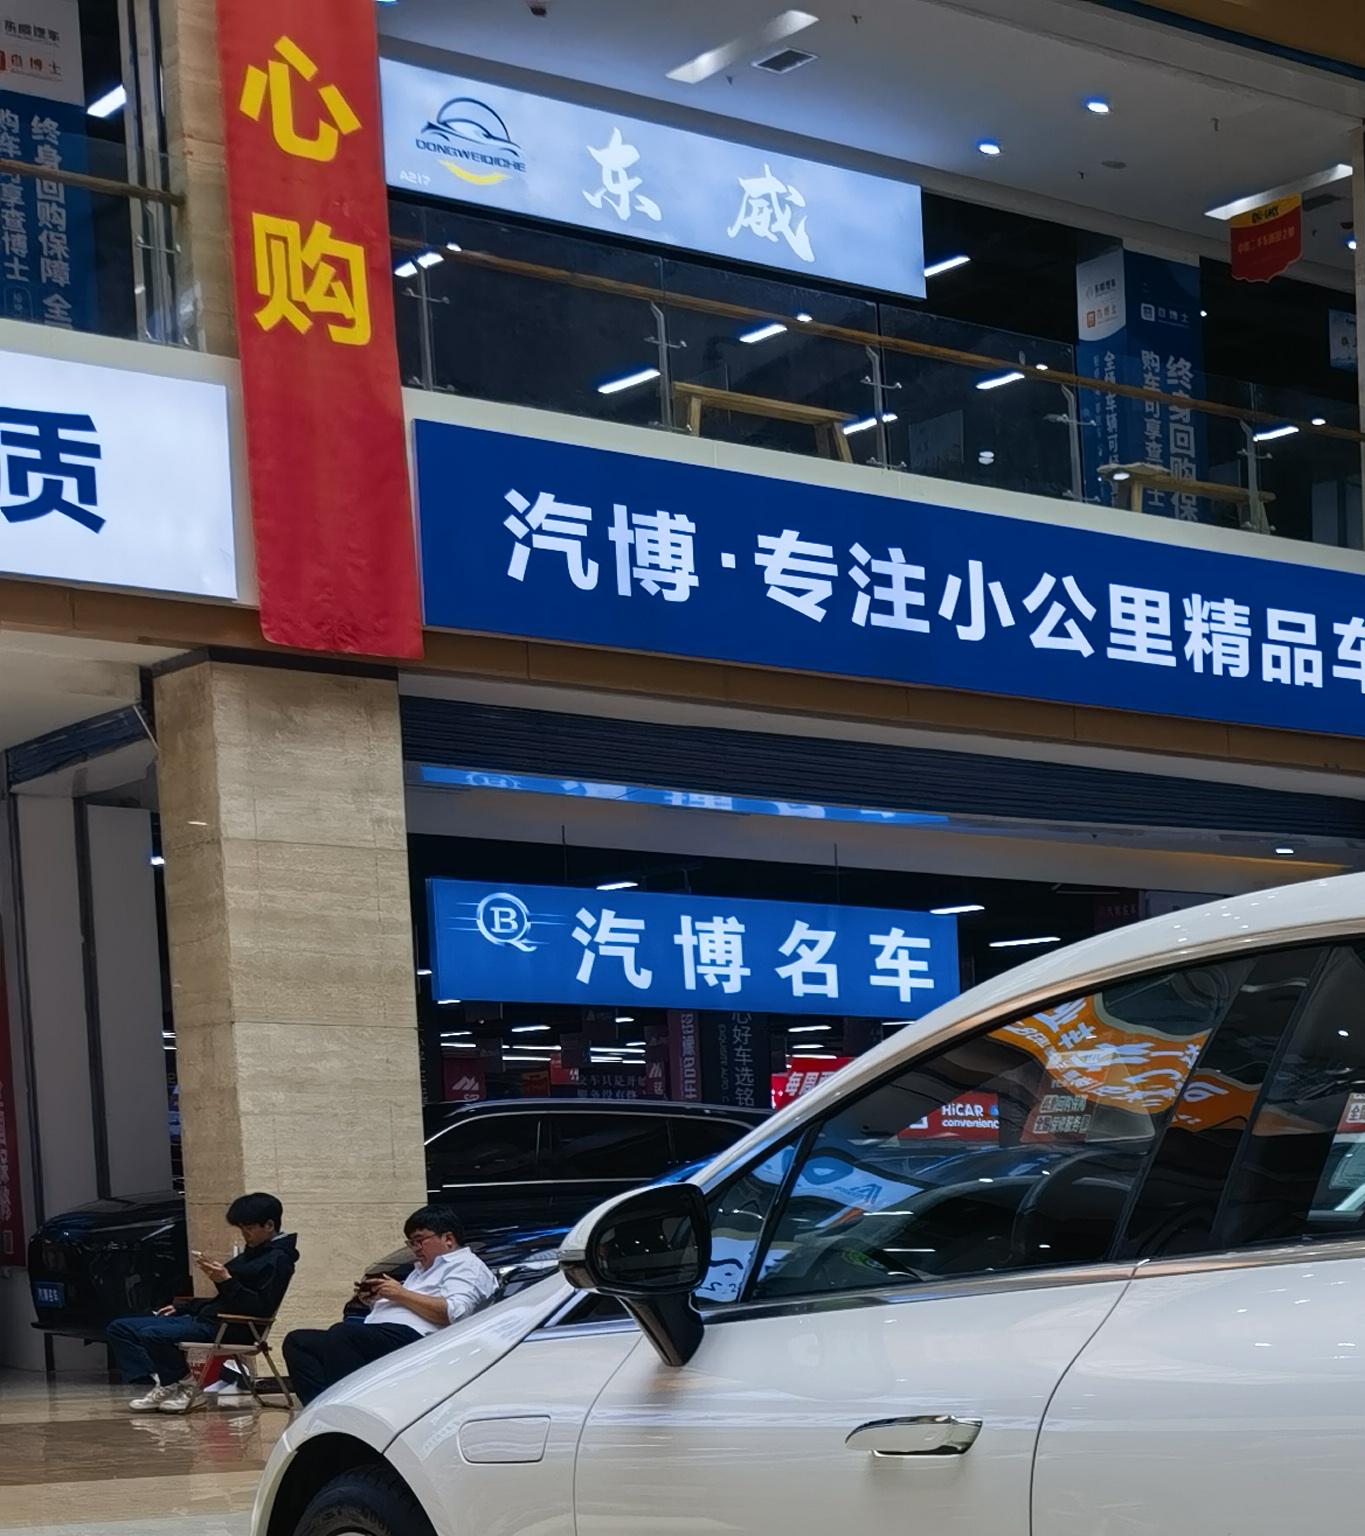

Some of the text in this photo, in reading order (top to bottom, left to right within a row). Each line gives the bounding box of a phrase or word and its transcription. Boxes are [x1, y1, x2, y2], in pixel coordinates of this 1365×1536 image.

[240, 35, 370, 345] 心购
[571, 907, 937, 1003] 汽博名车
